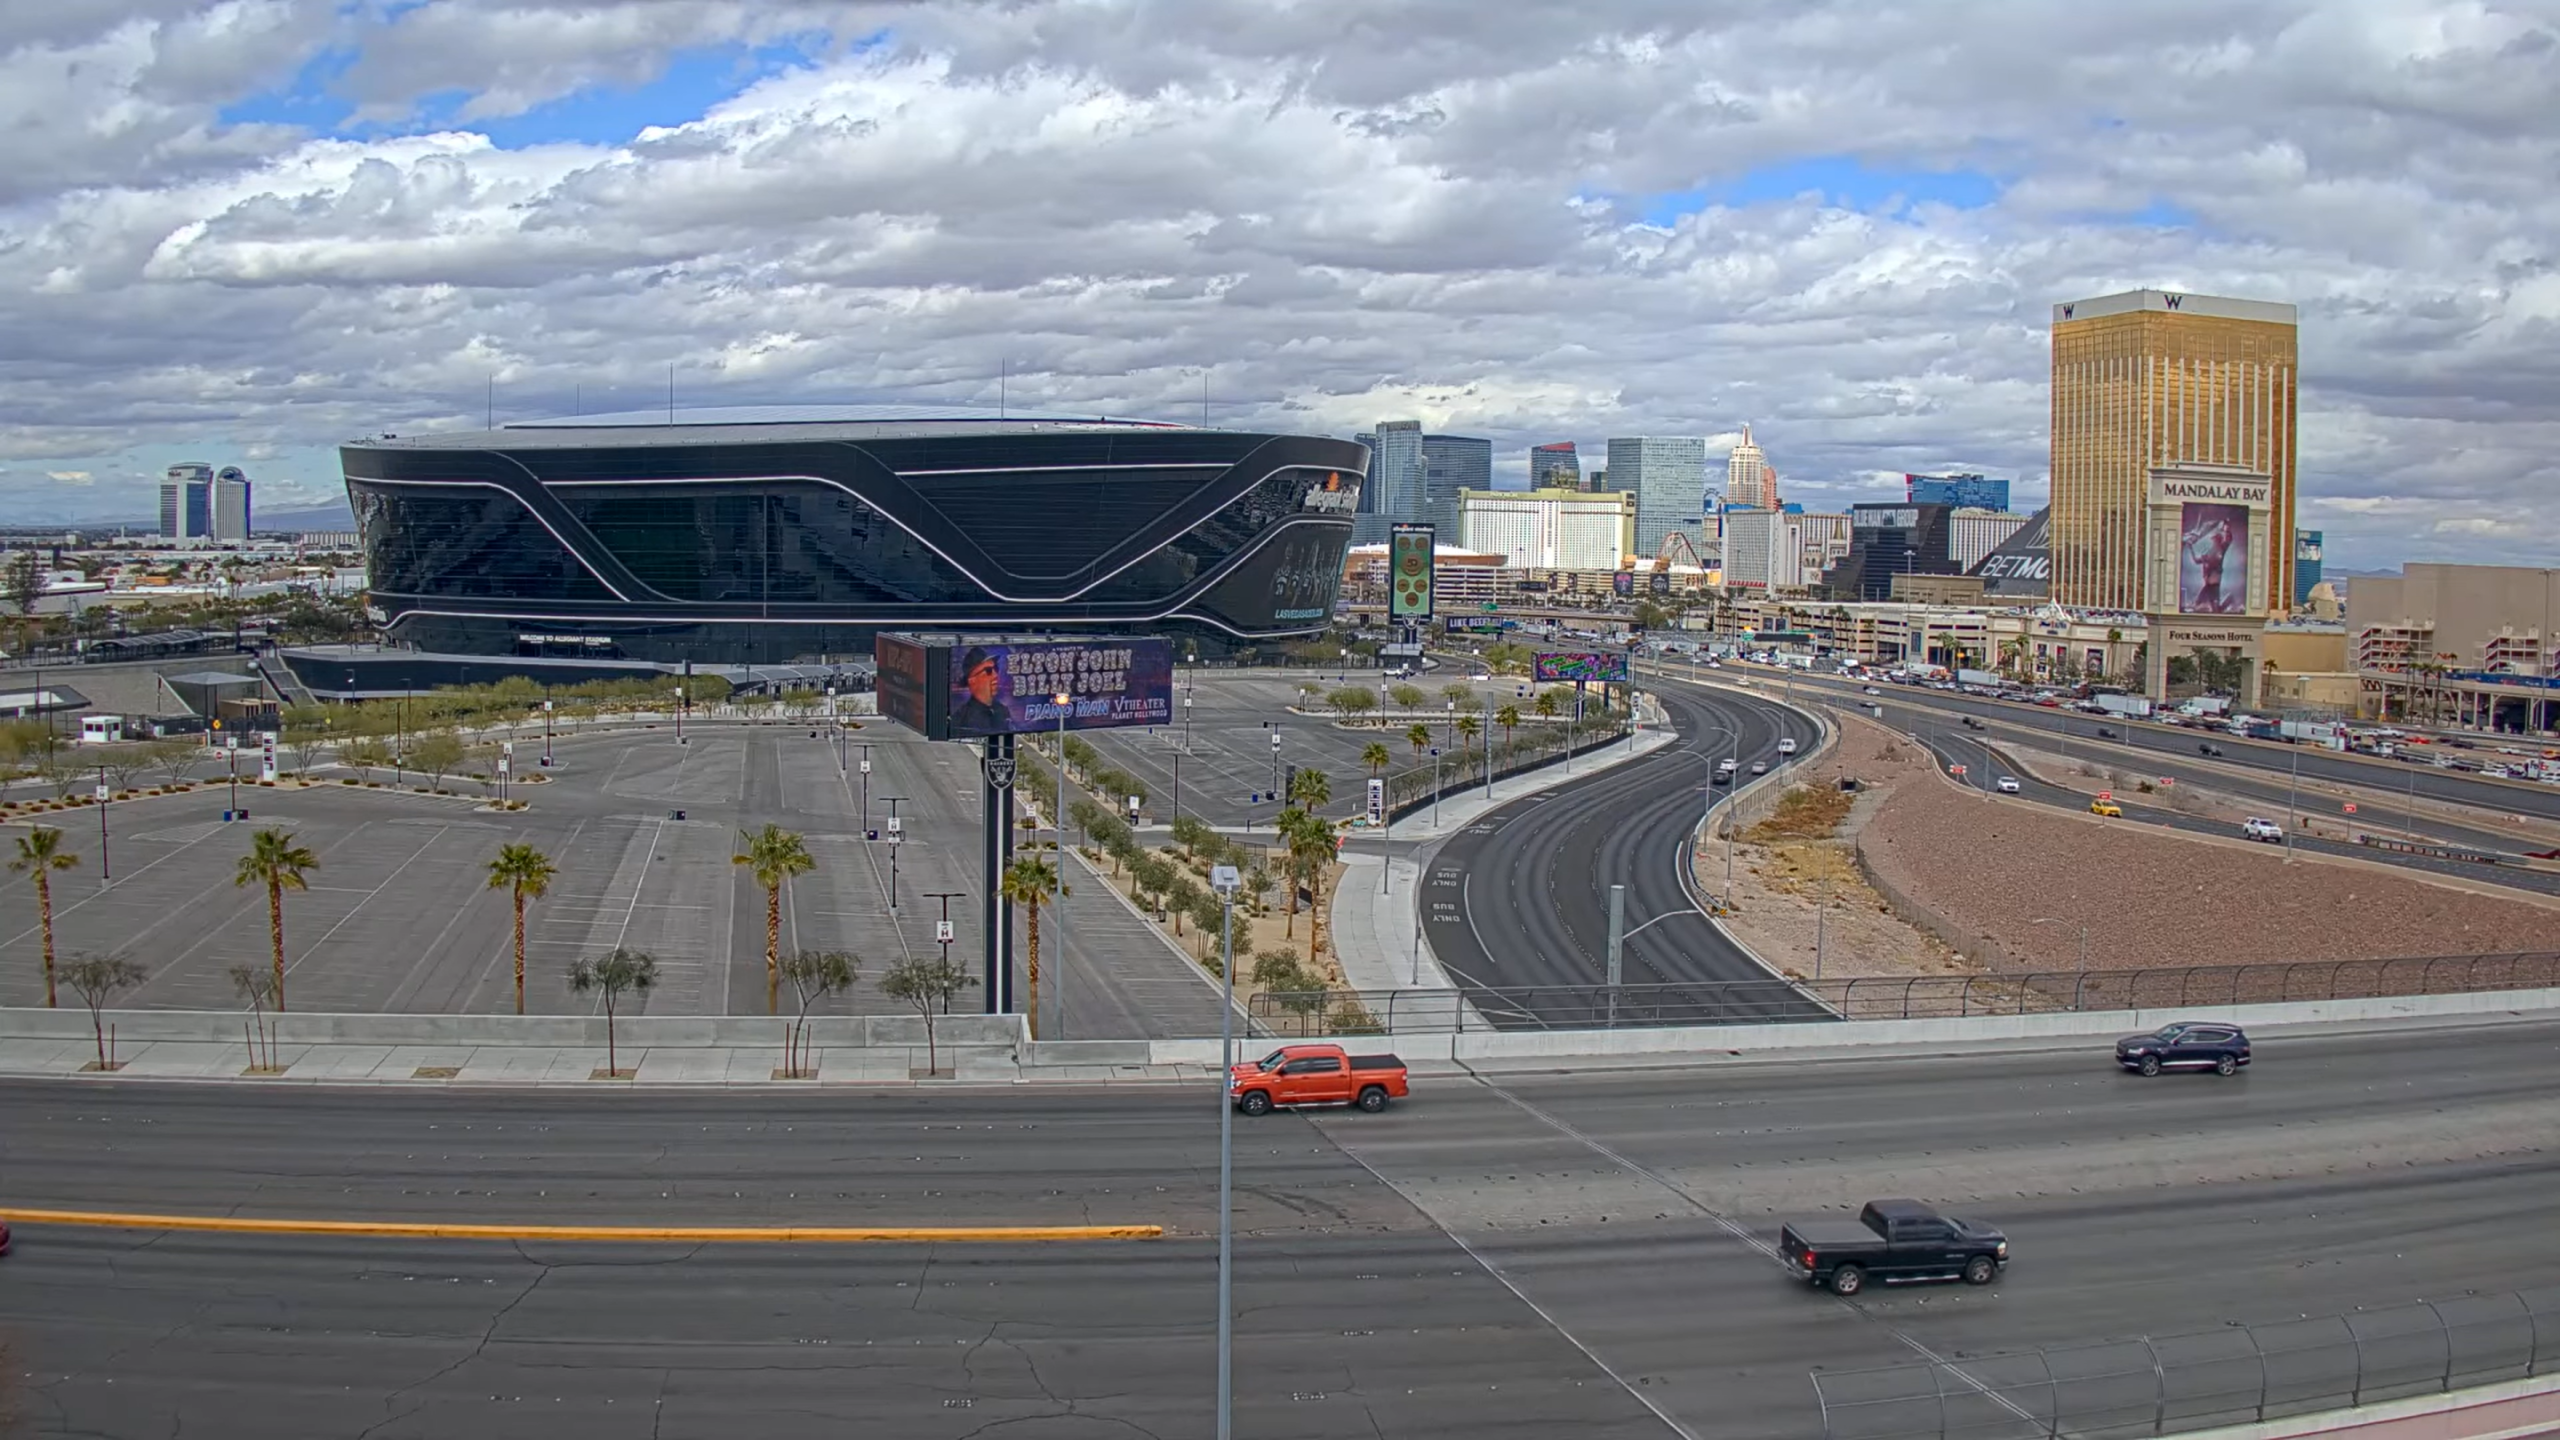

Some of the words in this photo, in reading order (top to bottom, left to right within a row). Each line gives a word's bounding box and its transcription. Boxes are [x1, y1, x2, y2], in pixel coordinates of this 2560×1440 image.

[2164, 294, 2182, 310] W
[2063, 303, 2075, 320] W
[2165, 483, 2240, 499] MANDALAY
[2242, 487, 2267, 501] BAY
[1897, 509, 1919, 528] GROUP
[1979, 554, 2049, 580] BETMG
[2227, 632, 2254, 642] HOTEL
[1006, 651, 1075, 674] ELTON
[1077, 648, 1133, 672] JOHN
[1013, 673, 1075, 696] BILLY
[1077, 671, 1127, 693] JOEL
[1025, 702, 1073, 720] PIANO
[1076, 700, 1110, 717] MAN
[1112, 712, 1133, 720] PLANET
[1134, 709, 1168, 718] HOLLYWOOD
[1433, 914, 1460, 922] ONLY
[941, 929, 949, 938] H
